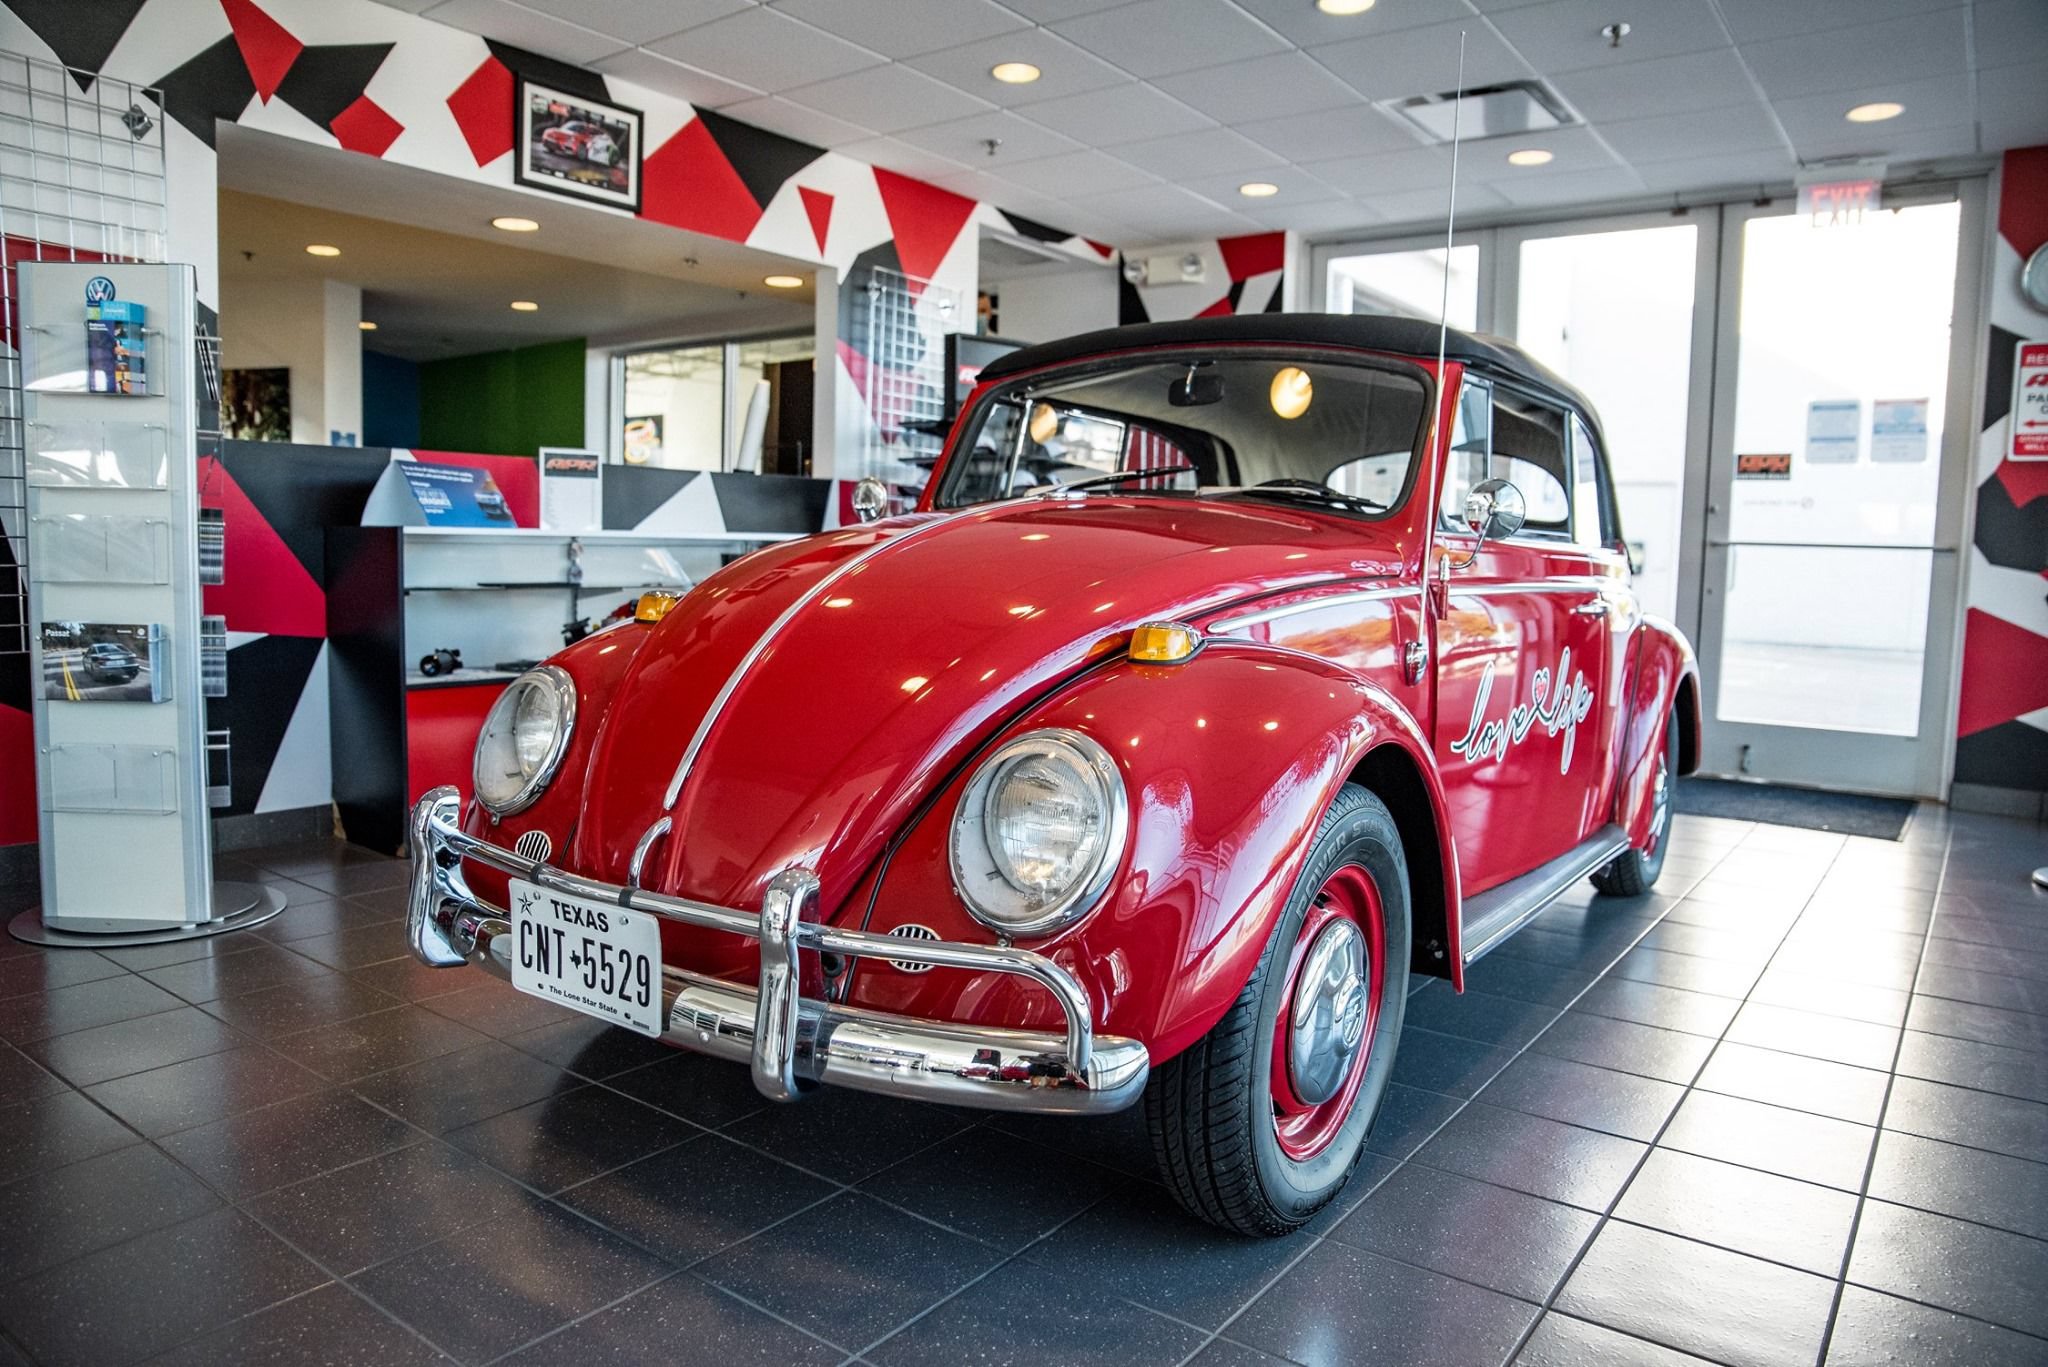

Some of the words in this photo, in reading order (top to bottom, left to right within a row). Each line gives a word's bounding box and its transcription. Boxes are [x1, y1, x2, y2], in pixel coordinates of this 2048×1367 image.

[1809, 181, 1872, 228] EXIT
[45, 628, 71, 637] Passat
[1296, 831, 1347, 917] POWER
[550, 899, 609, 933] TEXAS
[549, 985, 562, 996] The
[563, 990, 580, 1002] Lone
[582, 997, 597, 1008] Star
[598, 1002, 618, 1015] State
